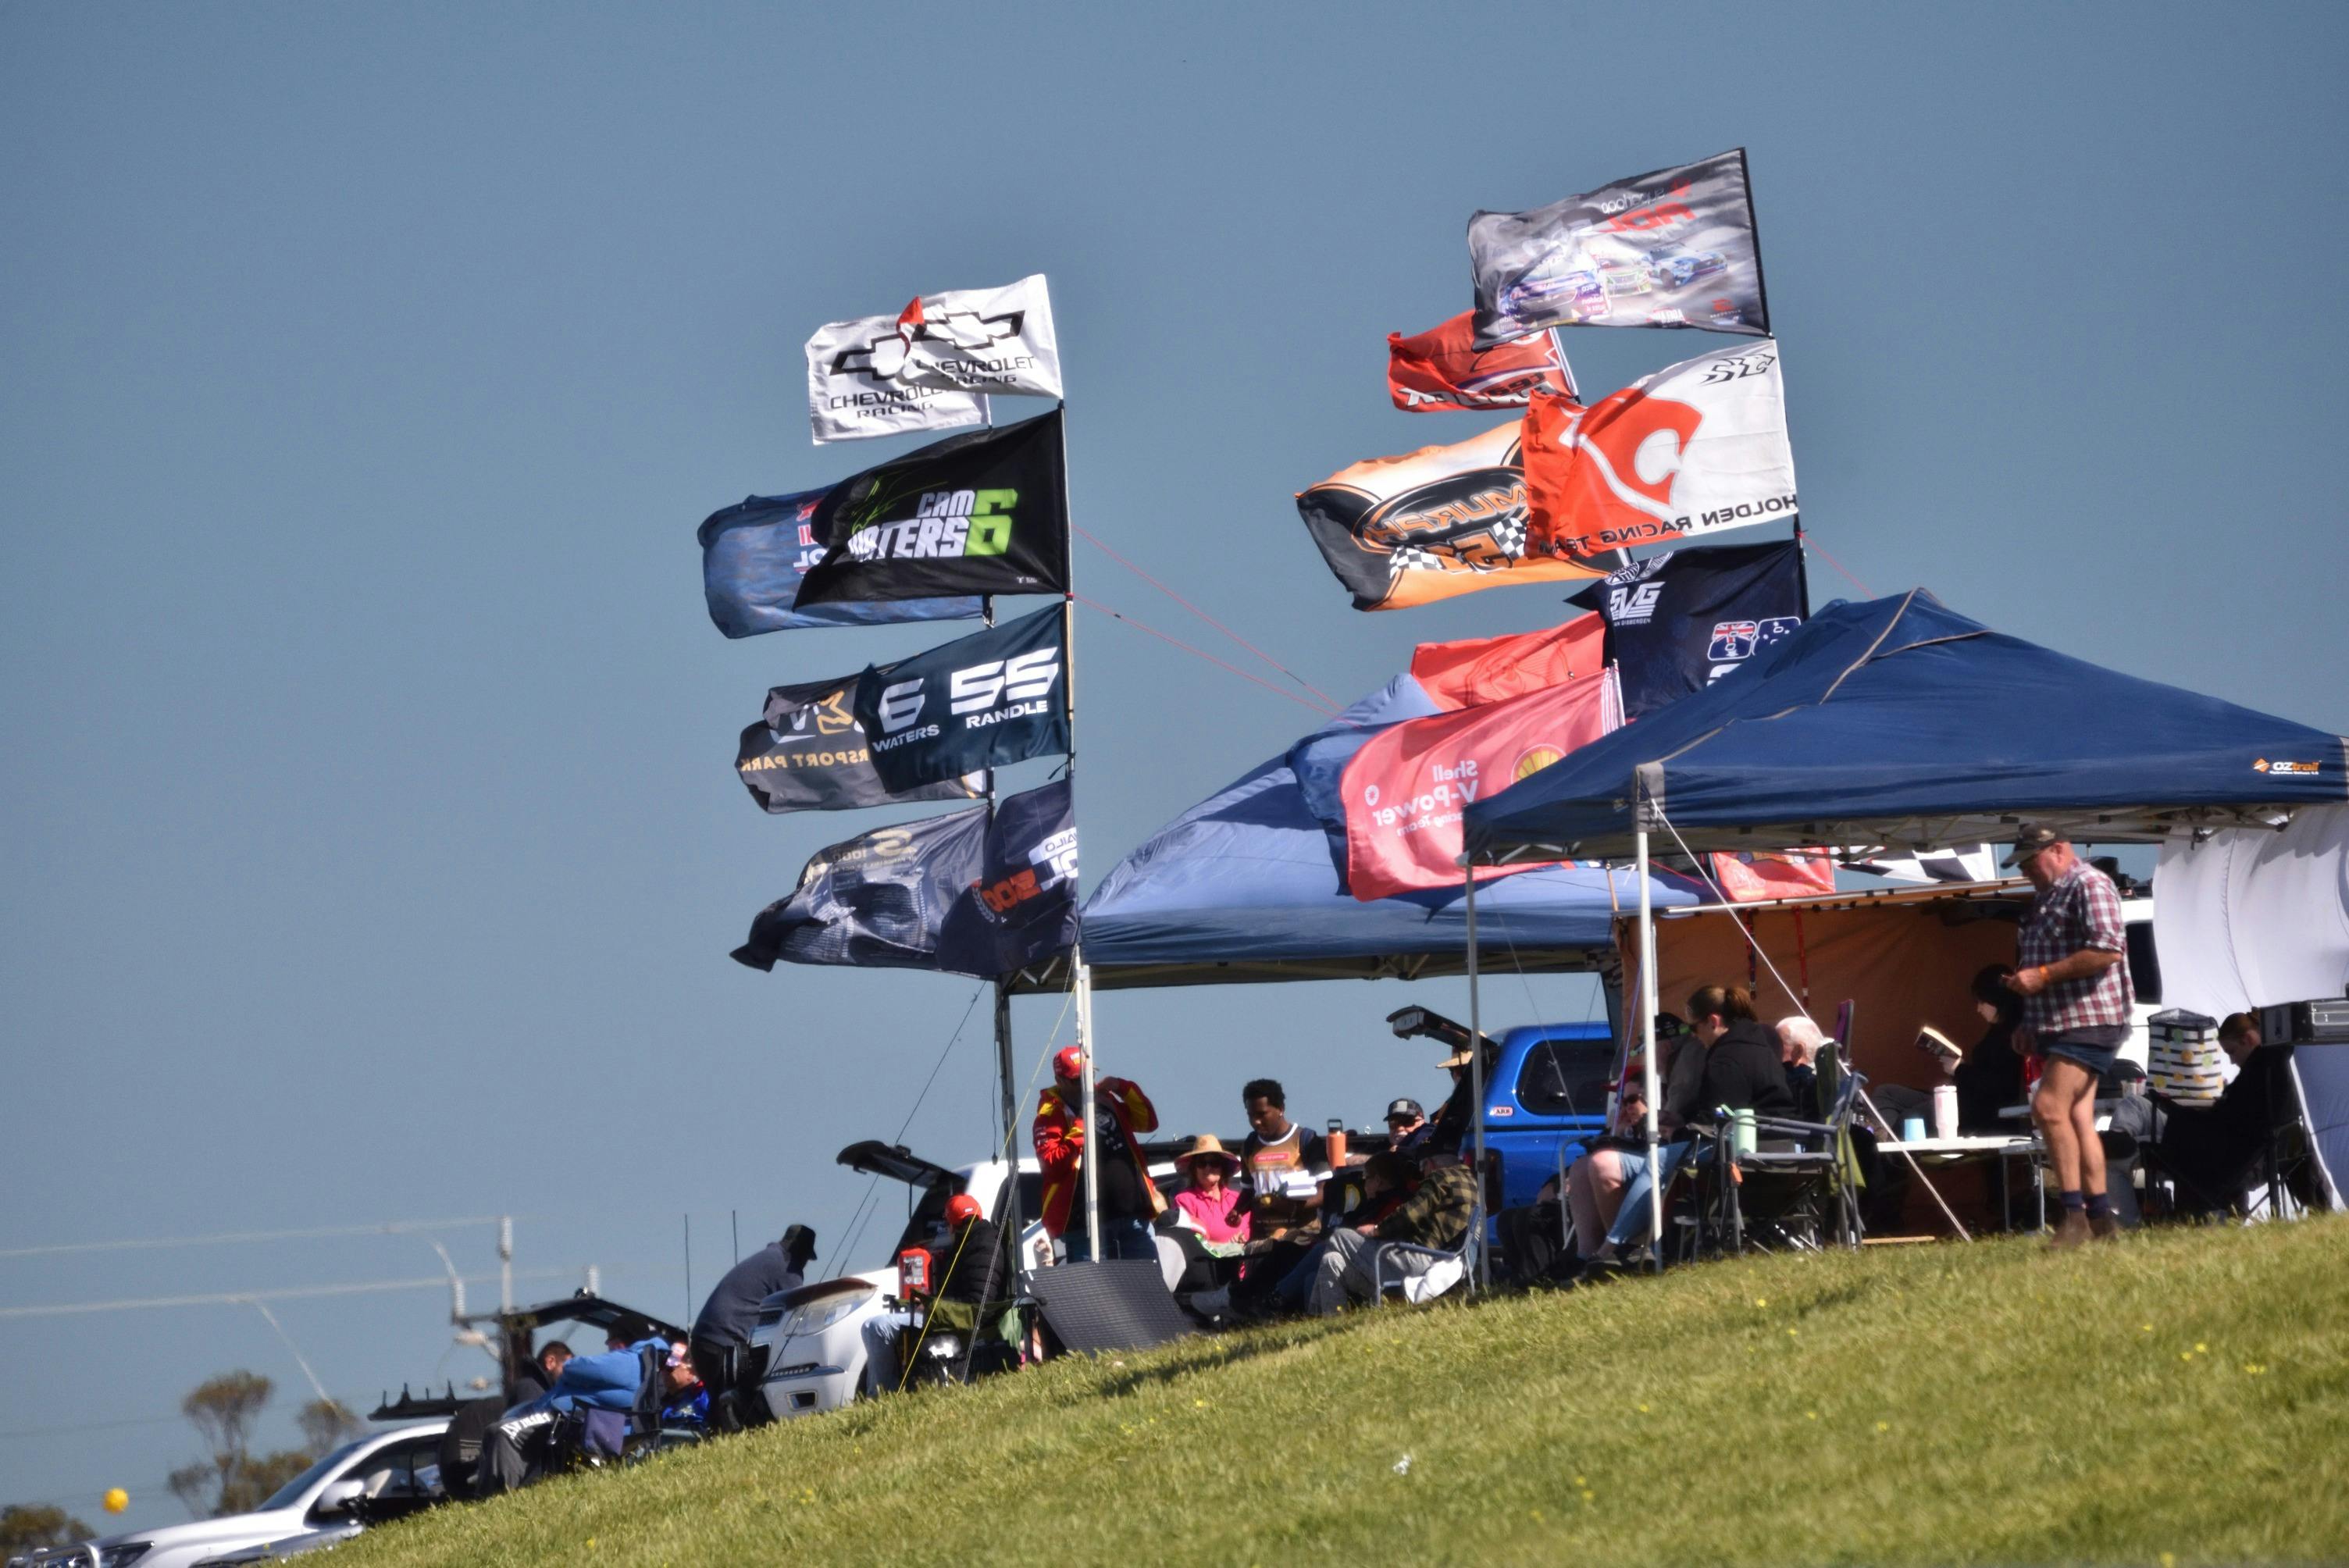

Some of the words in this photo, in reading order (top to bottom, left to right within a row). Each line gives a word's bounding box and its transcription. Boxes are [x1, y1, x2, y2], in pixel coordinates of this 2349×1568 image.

[857, 401, 933, 419] RACING
[916, 490, 975, 518] CAM
[964, 488, 1018, 556] 6
[1609, 581, 1666, 621] SVG
[878, 678, 925, 733] 6
[950, 647, 1059, 715] 55
[872, 724, 940, 753] WATERS
[965, 700, 1049, 729] RANDLE
